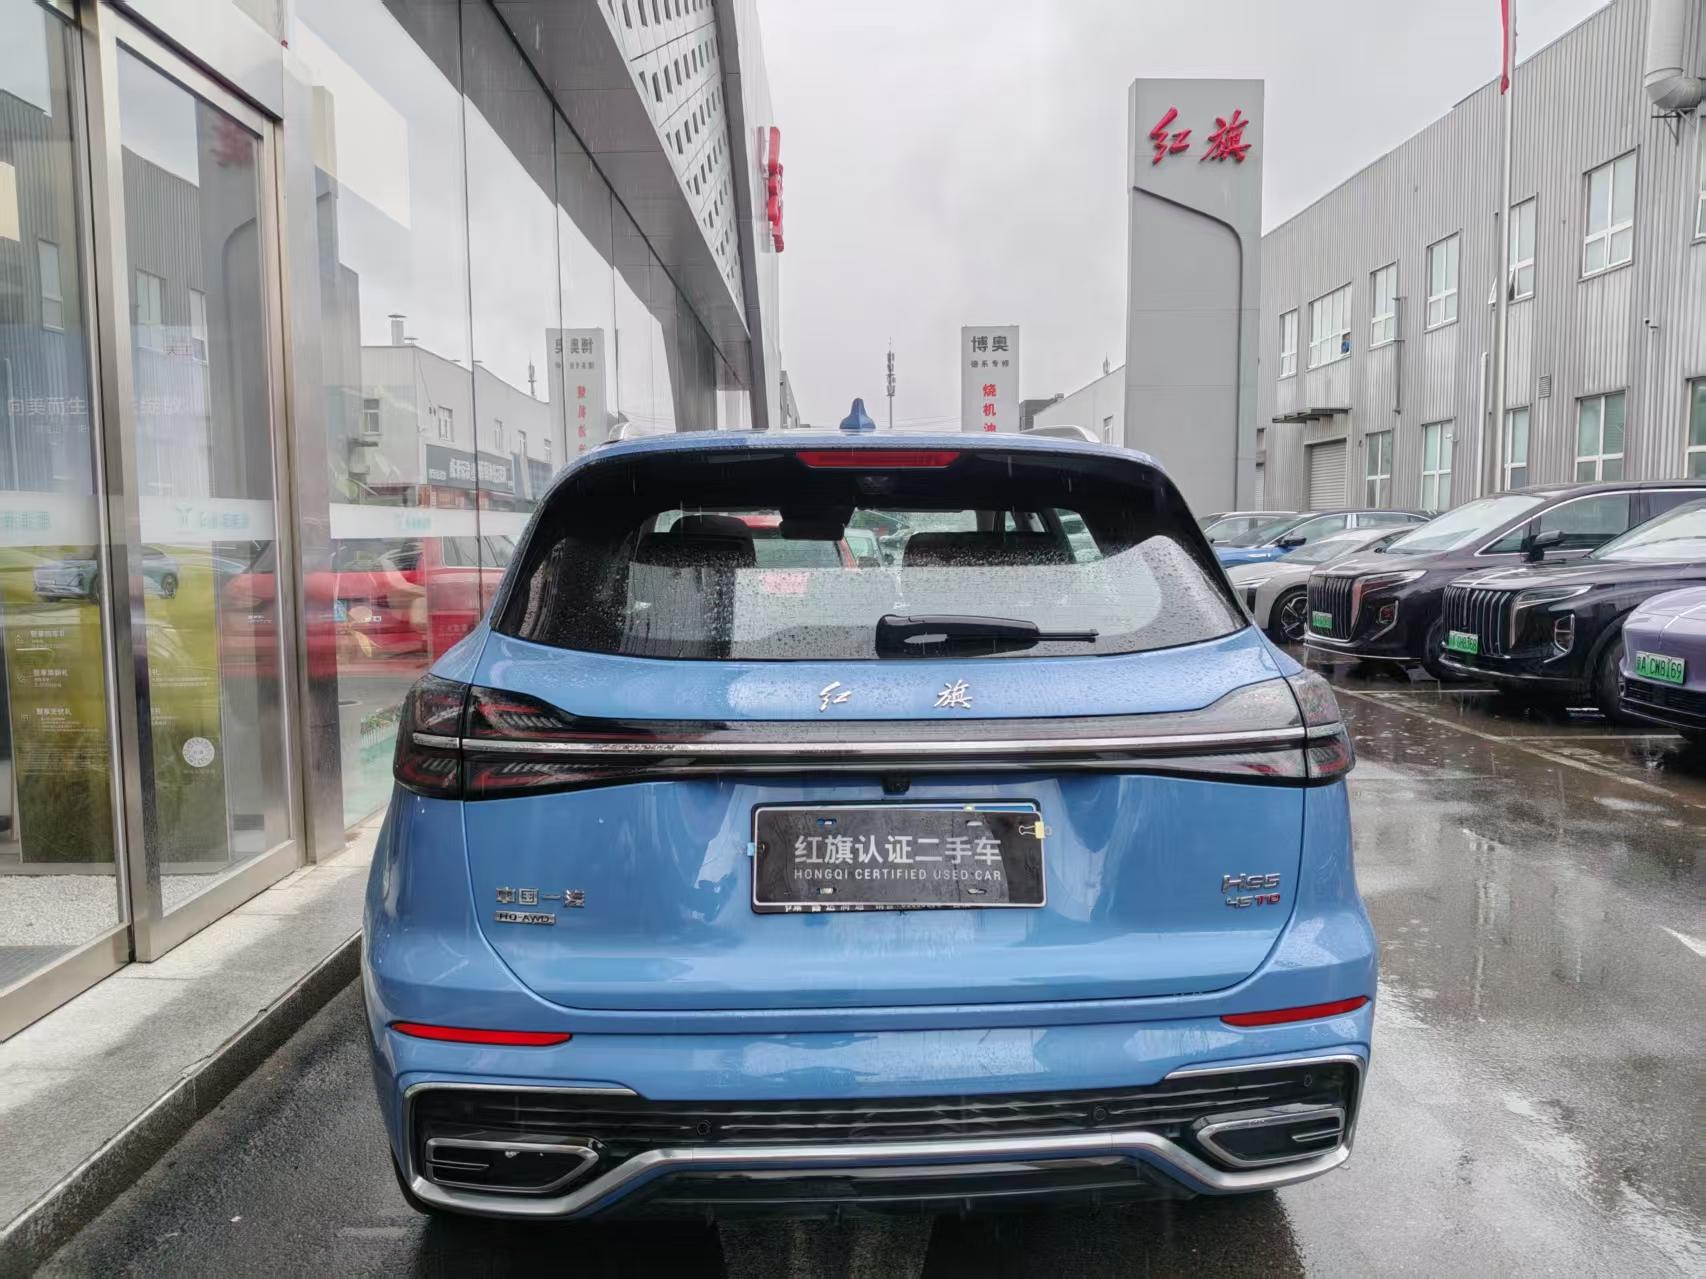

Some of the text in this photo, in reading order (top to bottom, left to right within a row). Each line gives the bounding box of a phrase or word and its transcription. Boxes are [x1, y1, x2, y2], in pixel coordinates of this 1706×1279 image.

[1149, 105, 1252, 166] 红旗
[971, 335, 1009, 353] 博奥
[819, 680, 973, 712] 红旗
[794, 835, 1002, 866] 红旗认证二手车
[794, 868, 1001, 881] HONGQI CERTIFIED USED CAR
